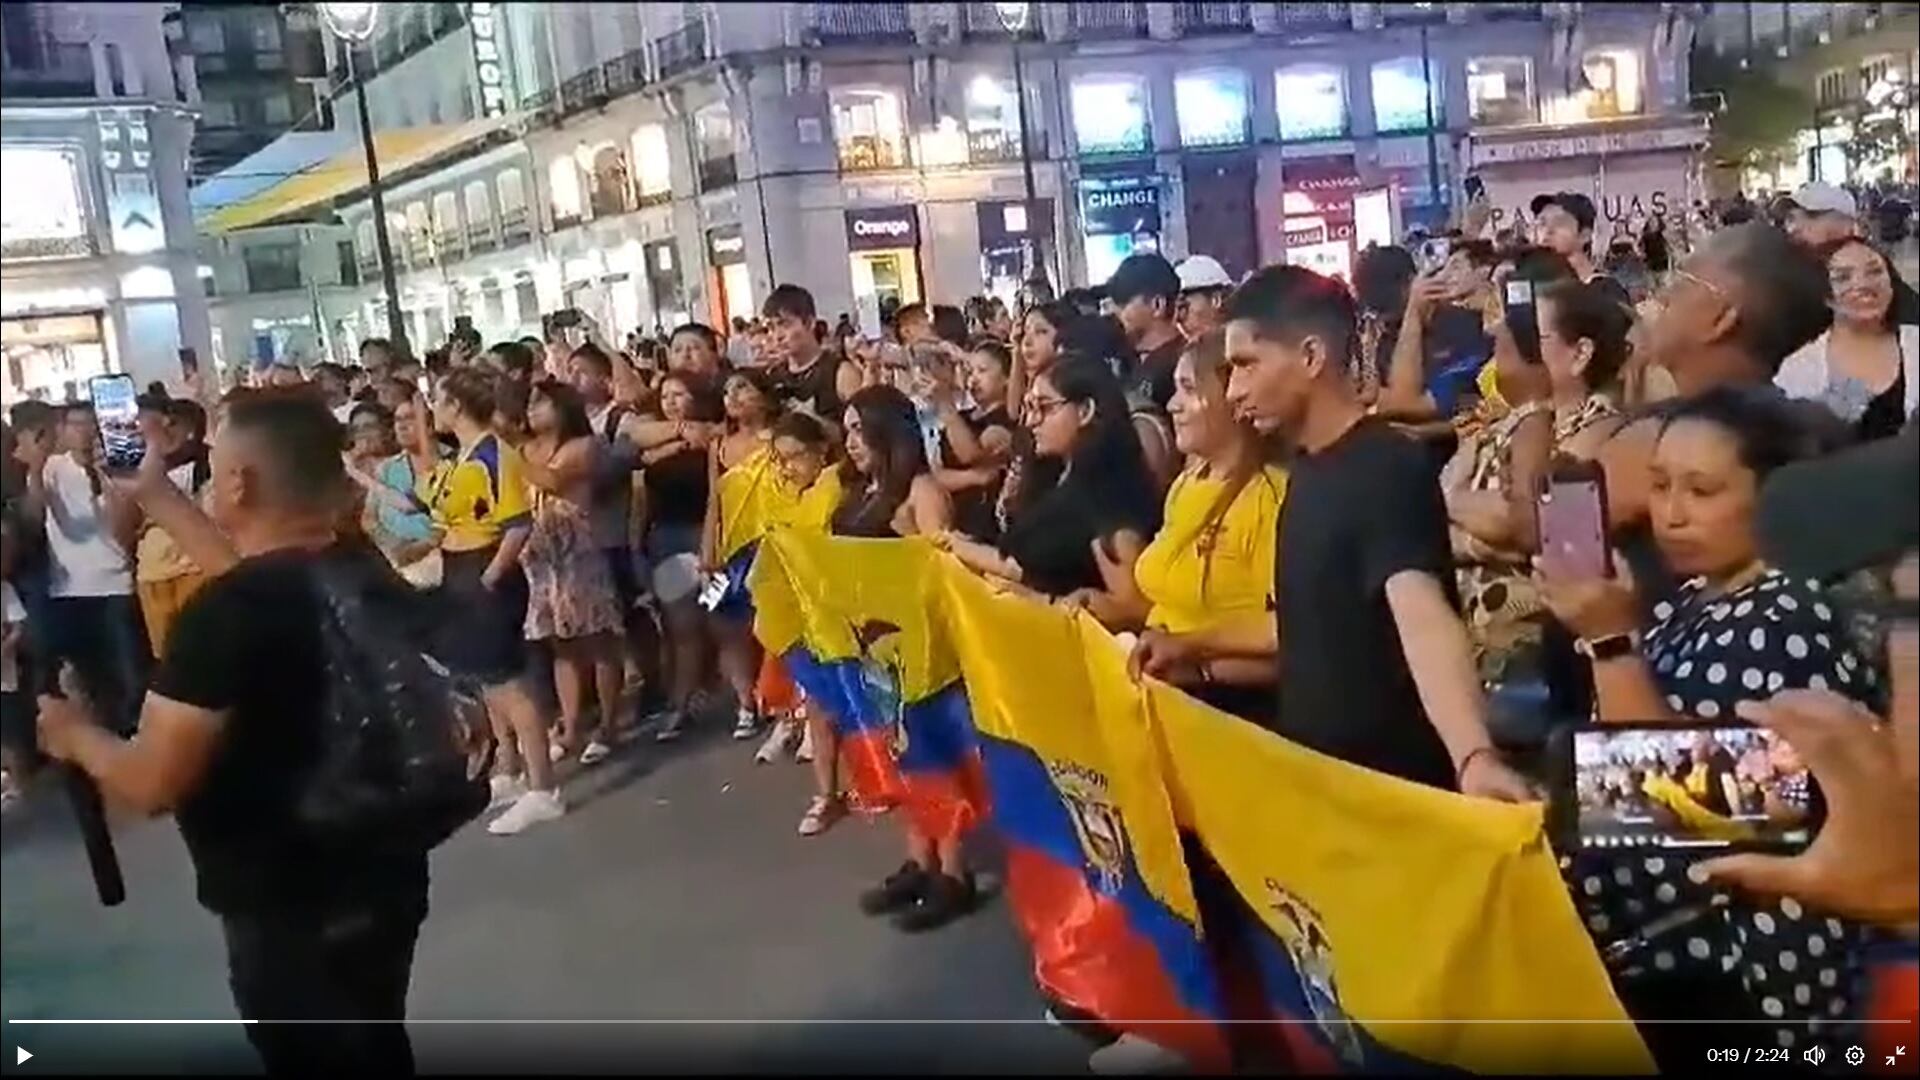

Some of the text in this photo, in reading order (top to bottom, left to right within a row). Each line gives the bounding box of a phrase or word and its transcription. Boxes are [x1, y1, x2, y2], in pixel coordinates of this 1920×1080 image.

[1088, 190, 1155, 208] CHANGE
[1491, 191, 1667, 231] PAUAS
[854, 219, 910, 236] Orange
